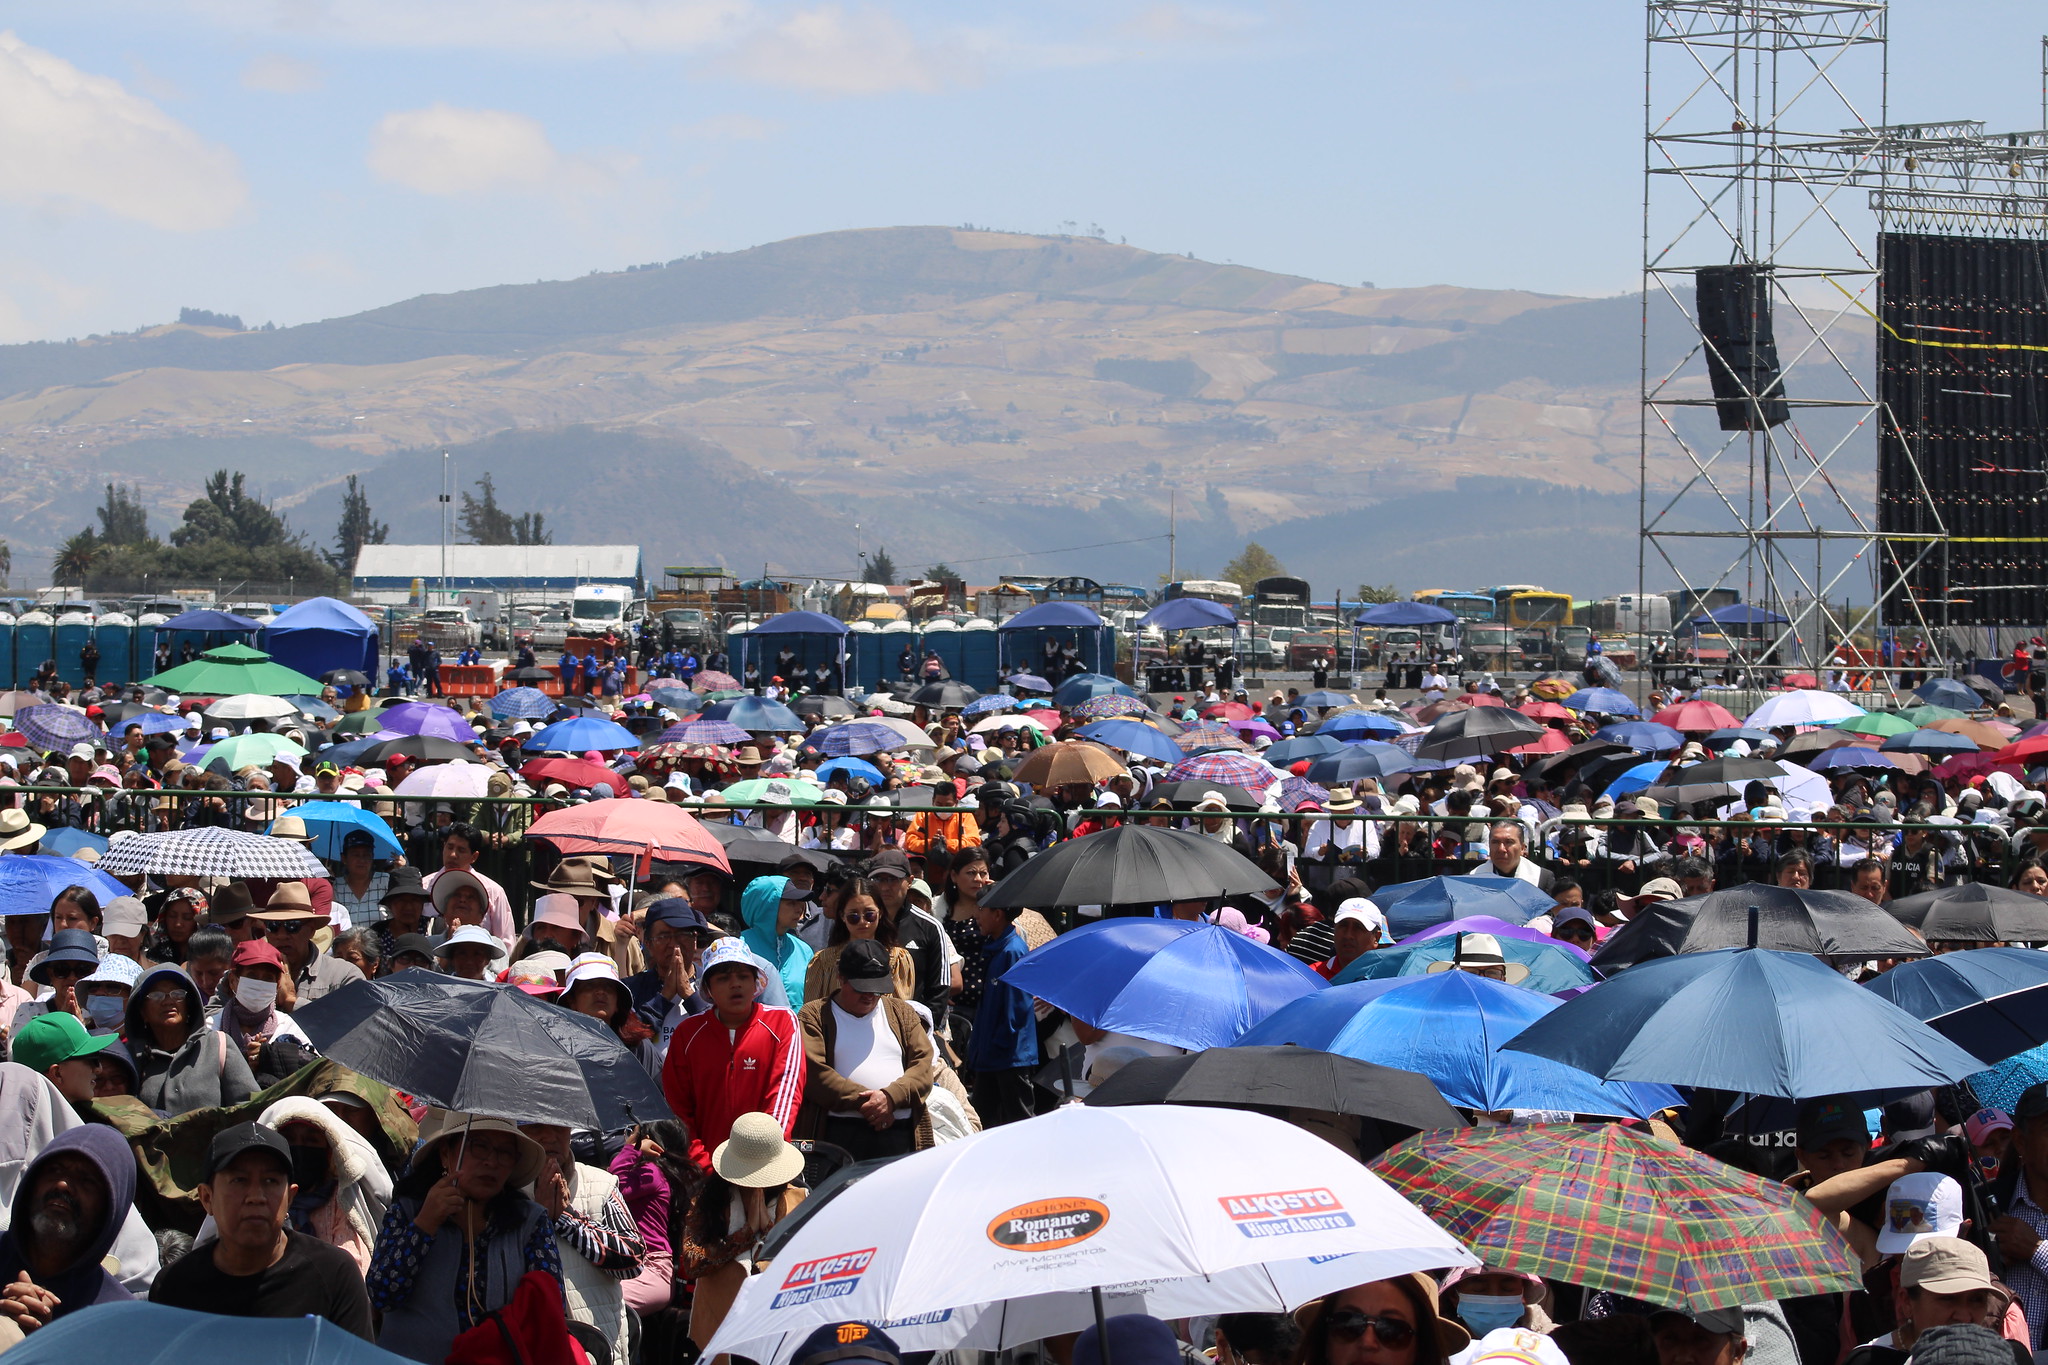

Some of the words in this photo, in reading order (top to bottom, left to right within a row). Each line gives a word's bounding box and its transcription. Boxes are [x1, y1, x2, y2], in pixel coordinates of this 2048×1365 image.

[1891, 861, 1921, 872] POICIA
[1010, 1200, 1087, 1217] COLCHONES
[1227, 1190, 1336, 1217] ALKOSTO
[1009, 1212, 1091, 1234] Romance
[1244, 1215, 1348, 1237] HiperAhorro
[1025, 1227, 1076, 1244] Relax
[787, 1250, 874, 1283] ALKOSTO
[775, 1281, 853, 1308] HiperAhorro
[836, 1323, 869, 1344] UTEP
